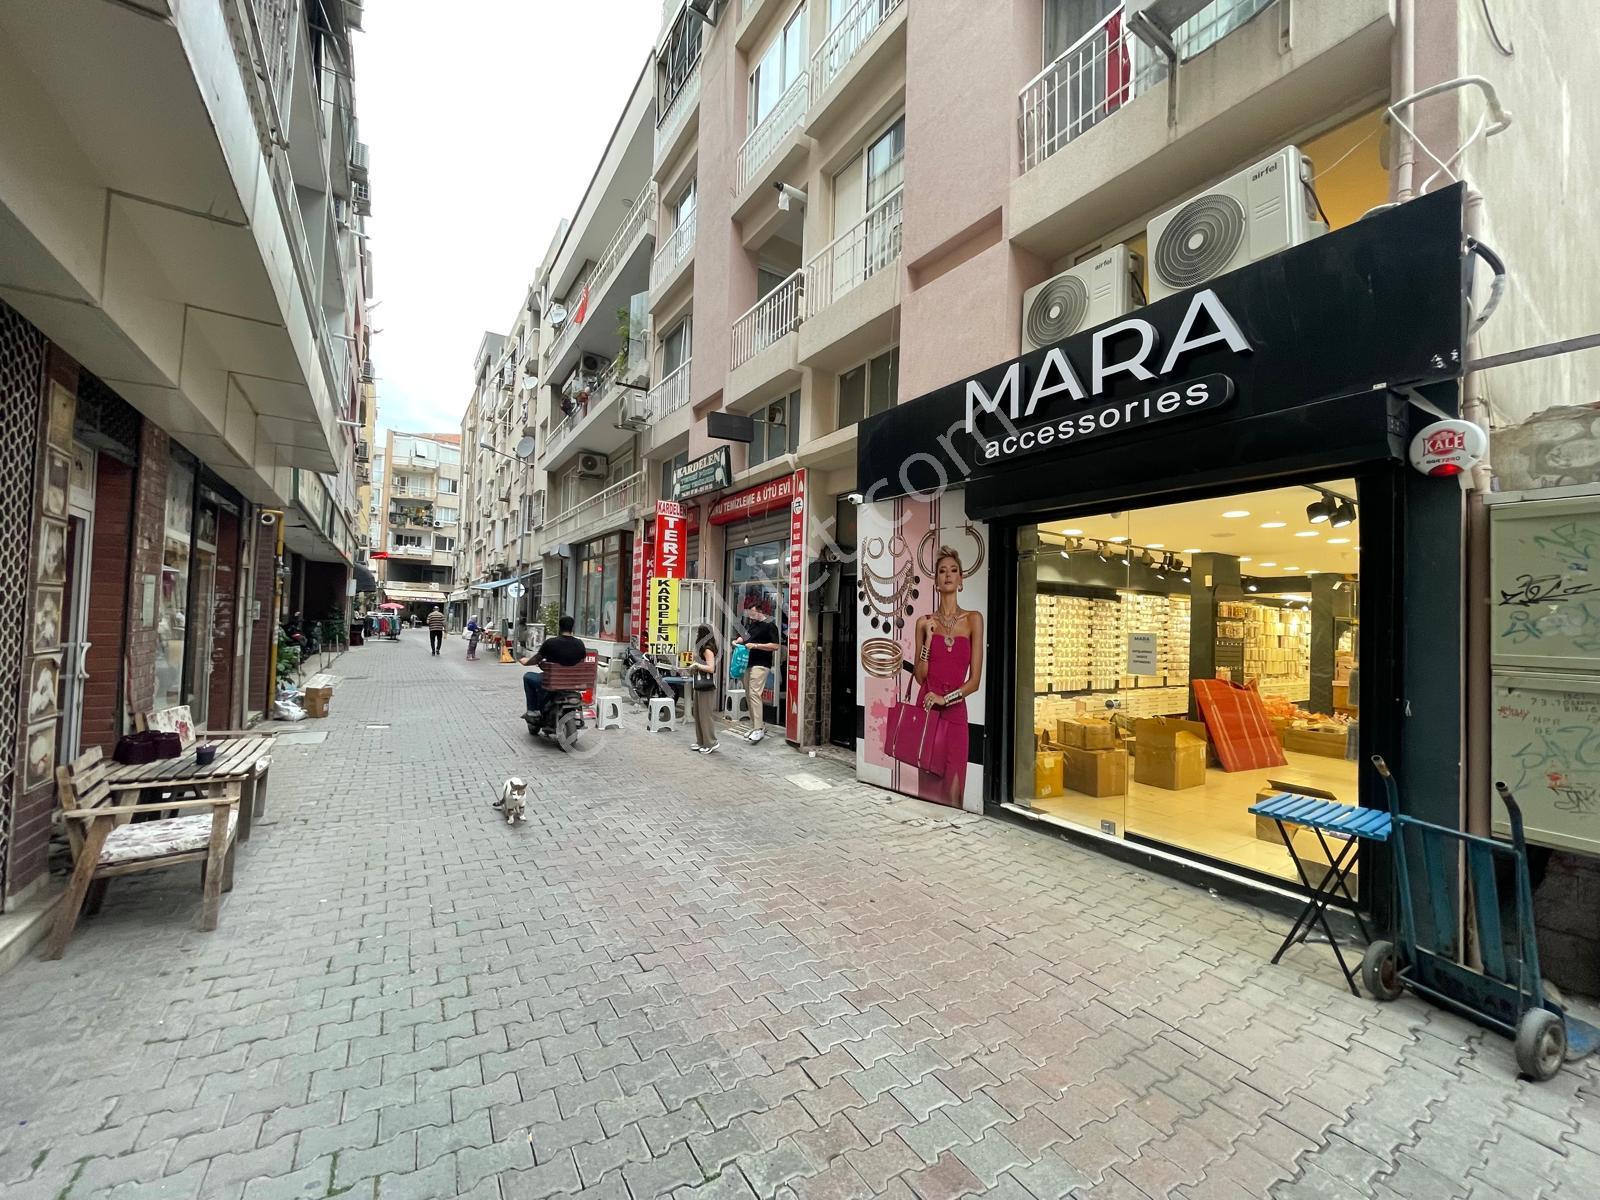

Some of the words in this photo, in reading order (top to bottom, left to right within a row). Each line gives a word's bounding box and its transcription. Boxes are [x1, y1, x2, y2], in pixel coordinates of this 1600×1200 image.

[1251, 162, 1278, 183] airfel
[1094, 257, 1113, 271] airfel
[965, 288, 1253, 434] MARA
[1424, 433, 1463, 455] KALE
[676, 451, 721, 479] KARDELEN
[658, 501, 687, 517] KARDELEN
[657, 579, 671, 642] KARDELEN
